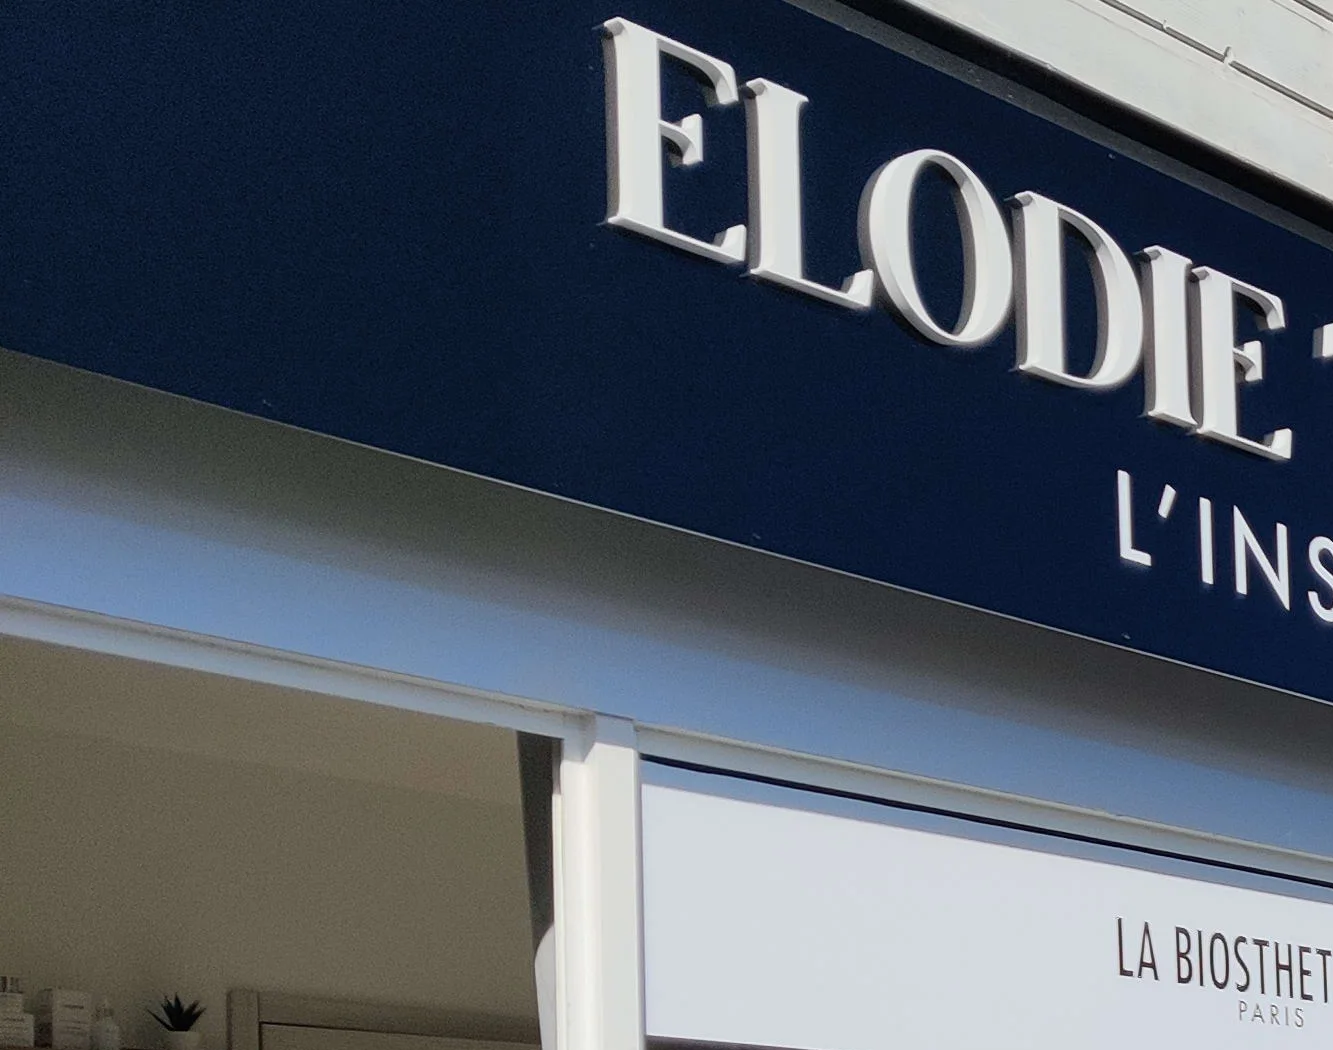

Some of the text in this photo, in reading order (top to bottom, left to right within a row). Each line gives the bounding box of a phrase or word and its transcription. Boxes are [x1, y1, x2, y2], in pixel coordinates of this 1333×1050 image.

[602, 17, 1292, 460] ELODIE
[1116, 917, 1159, 981] LA
[1239, 1000, 1305, 1028] PARIS
